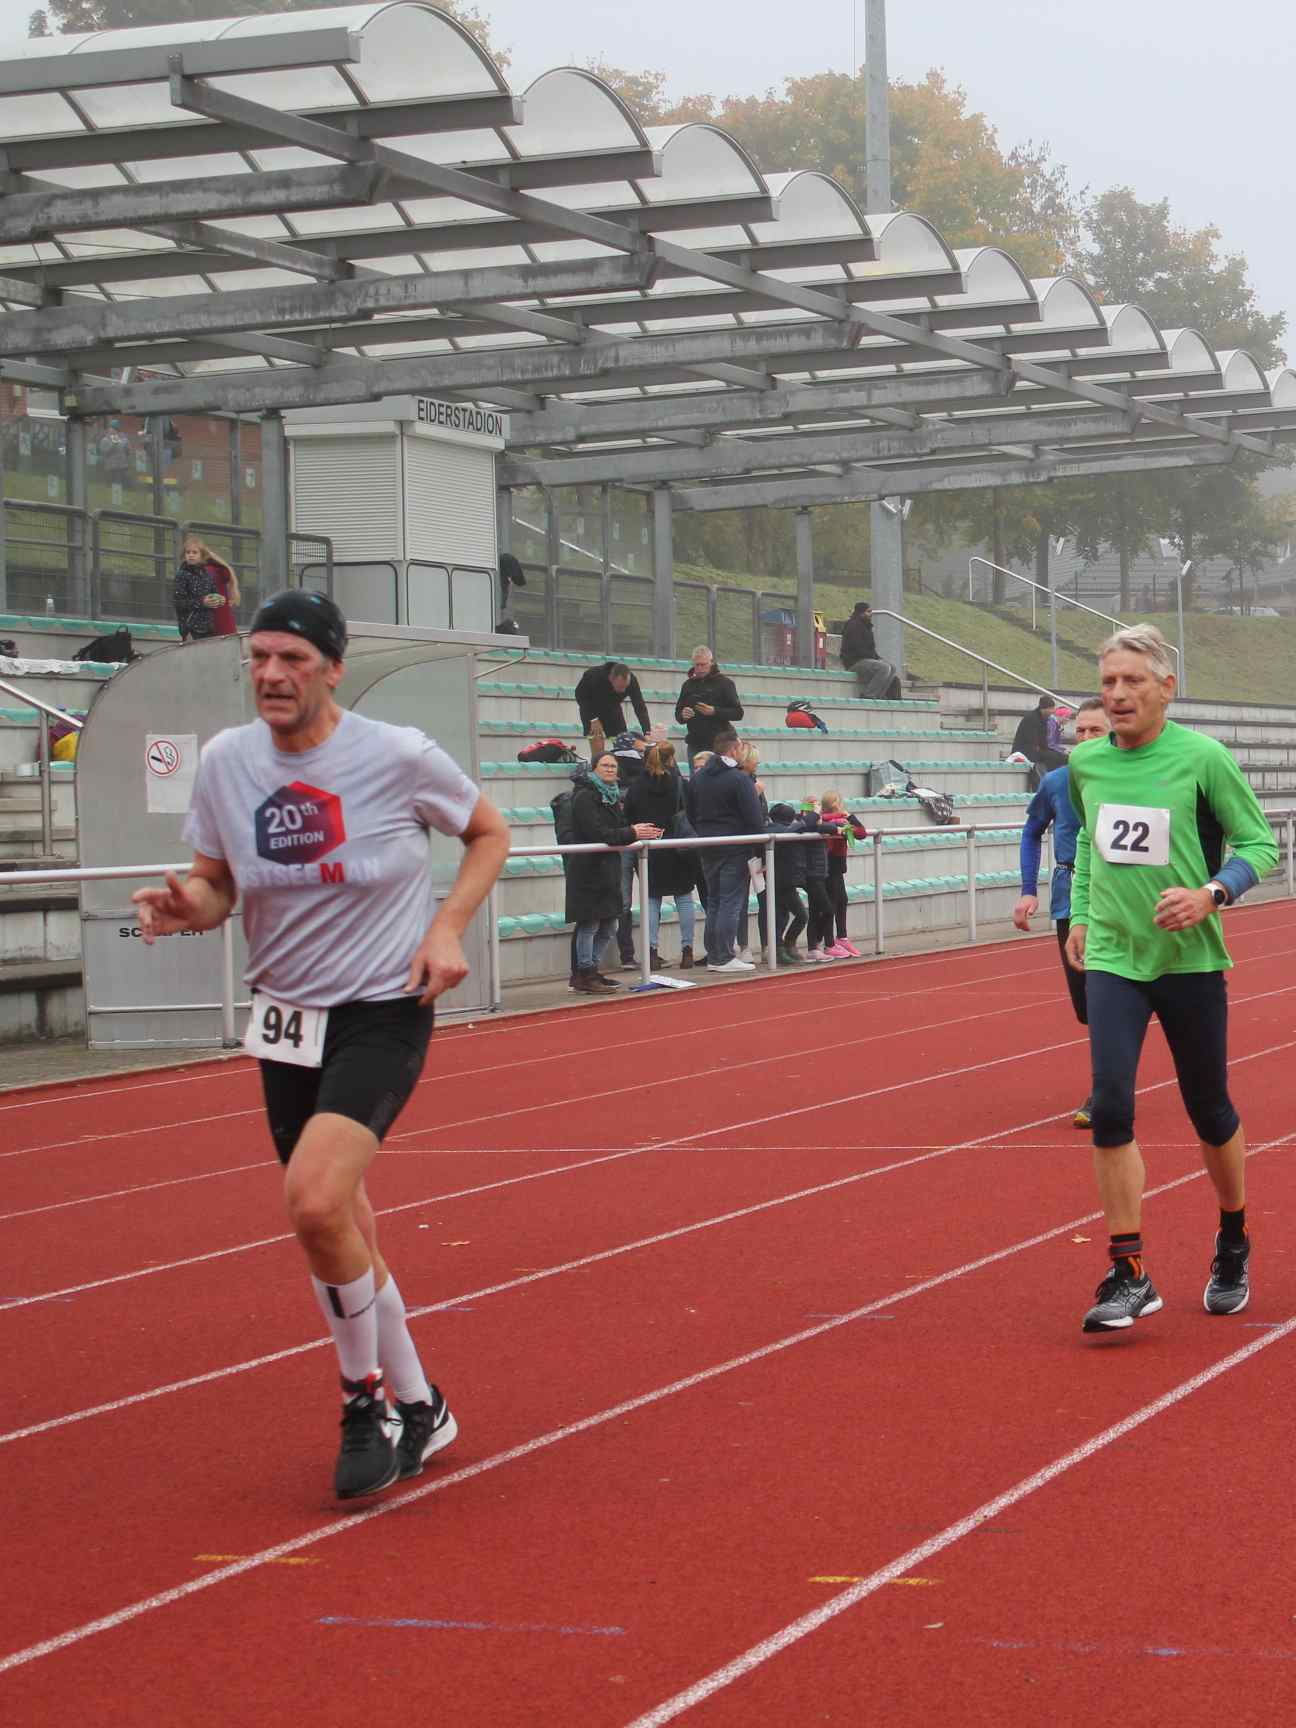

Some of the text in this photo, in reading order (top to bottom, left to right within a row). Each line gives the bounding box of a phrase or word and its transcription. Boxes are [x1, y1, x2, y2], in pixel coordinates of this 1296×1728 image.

[417, 399, 503, 437] EIDERSTADION
[270, 831, 325, 849] EDITION
[1110, 819, 1150, 853] 22
[261, 1004, 304, 1049] 94
